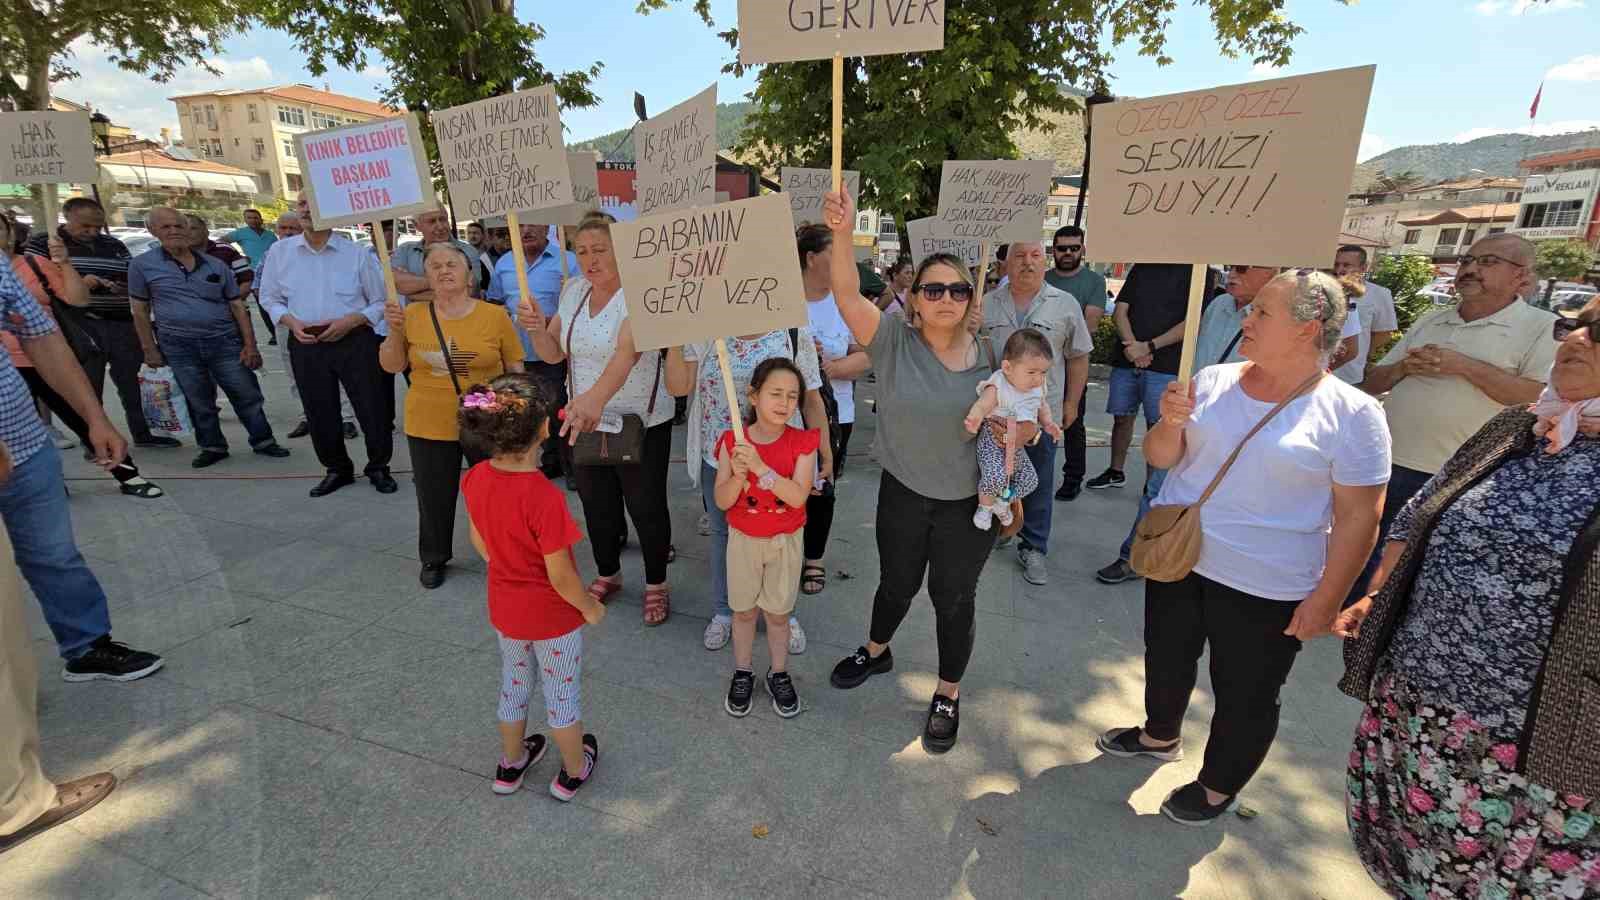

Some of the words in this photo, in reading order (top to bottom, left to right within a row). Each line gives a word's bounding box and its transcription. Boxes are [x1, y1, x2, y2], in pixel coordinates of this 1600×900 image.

[484, 94, 549, 128] HAKLARINI
[20, 120, 56, 144] HAK
[305, 138, 344, 161] KINIK
[346, 124, 407, 155] BELEDİYE
[11, 144, 62, 160] HUKUK
[1116, 130, 1274, 175] SESİMİZİ
[15, 162, 64, 176] ADALET
[331, 159, 391, 188] BAŞKANI
[482, 164, 540, 196] MEYDAN
[949, 168, 983, 189] HAK
[347, 186, 392, 211] İSTİFA
[957, 190, 1016, 204] ADALET
[632, 208, 746, 260] BABAMIN
[643, 278, 704, 314] GERİ
